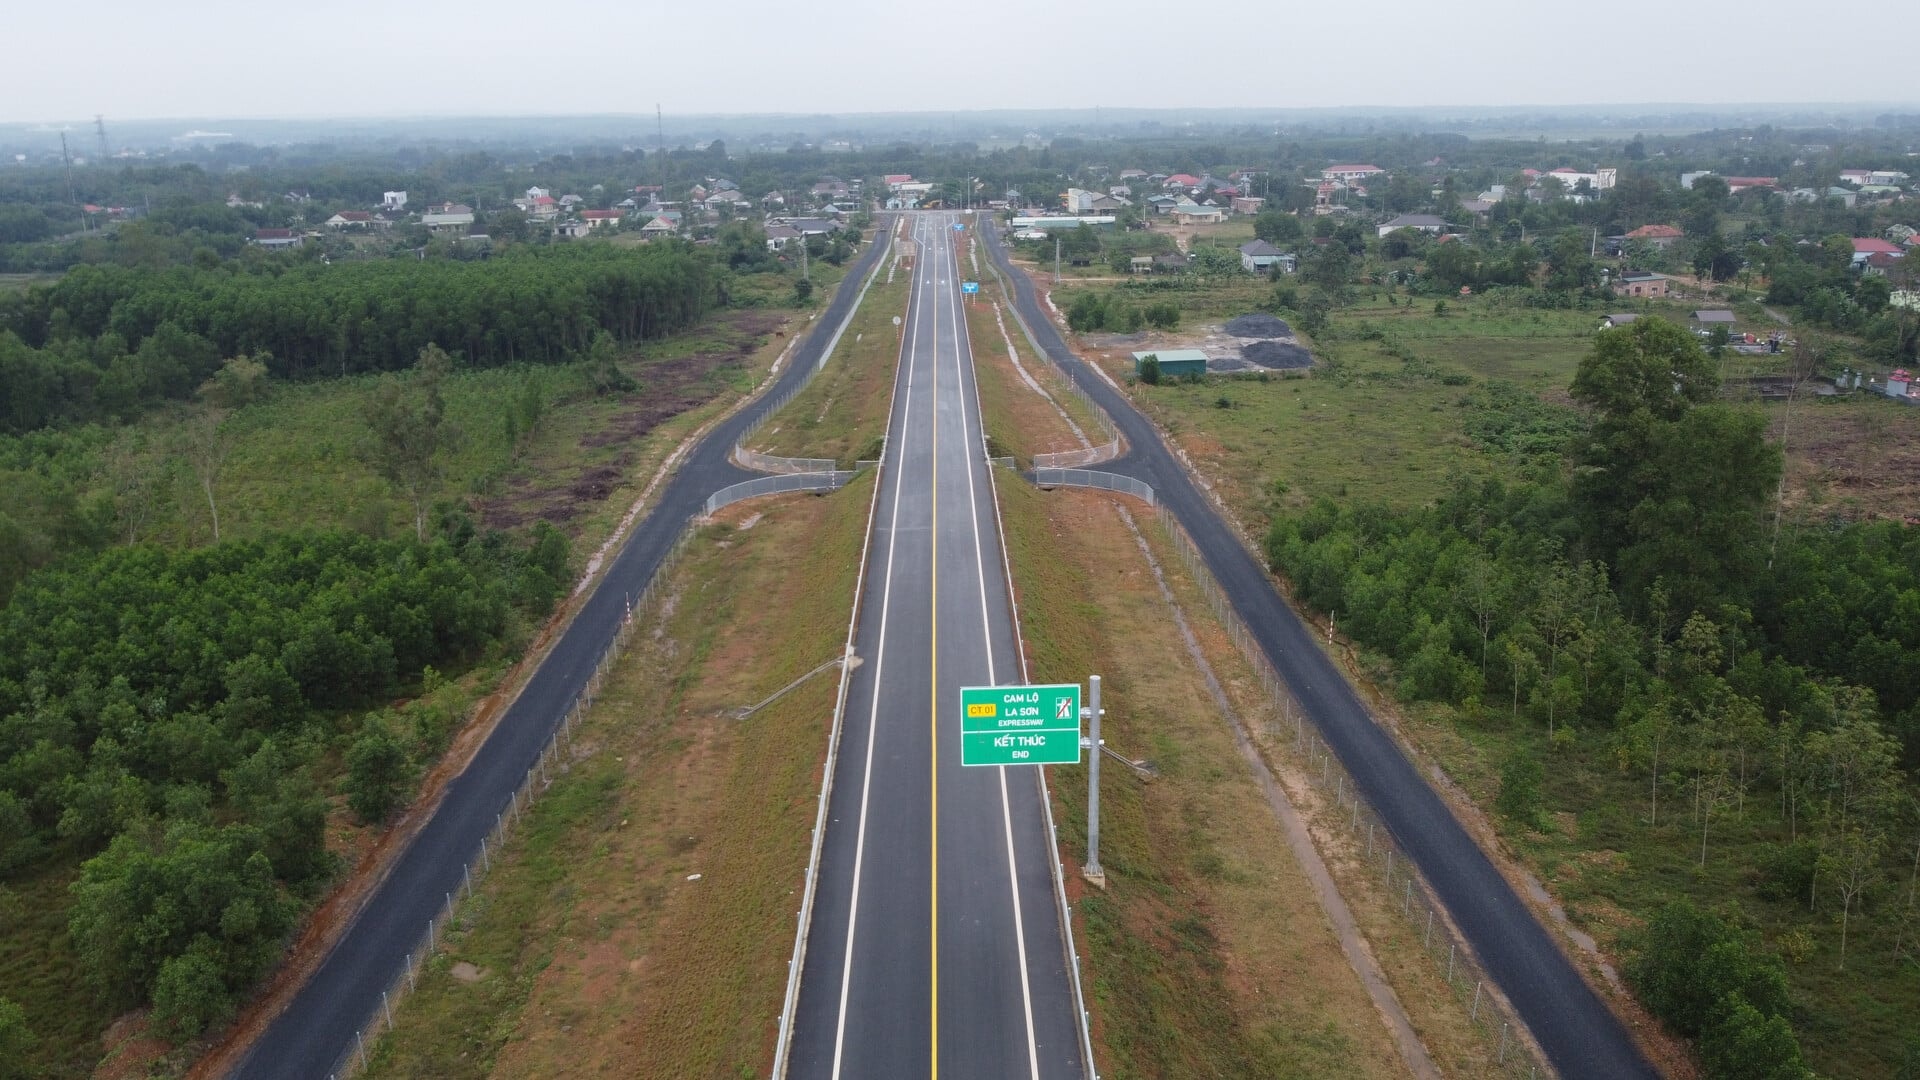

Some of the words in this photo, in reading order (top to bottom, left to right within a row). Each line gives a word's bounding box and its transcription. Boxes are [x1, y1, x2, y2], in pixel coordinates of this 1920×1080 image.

[1004, 694, 1024, 703] CAM
[1026, 692, 1039, 703] LỘ
[970, 706, 982, 714] CT
[984, 706, 994, 714] 01
[1020, 707, 1039, 716] SƠN
[998, 719, 1044, 727] EXPRESSWAY
[994, 734, 1015, 747] KẾT
[1018, 734, 1046, 746] THÚC
[1012, 751, 1030, 759] END
